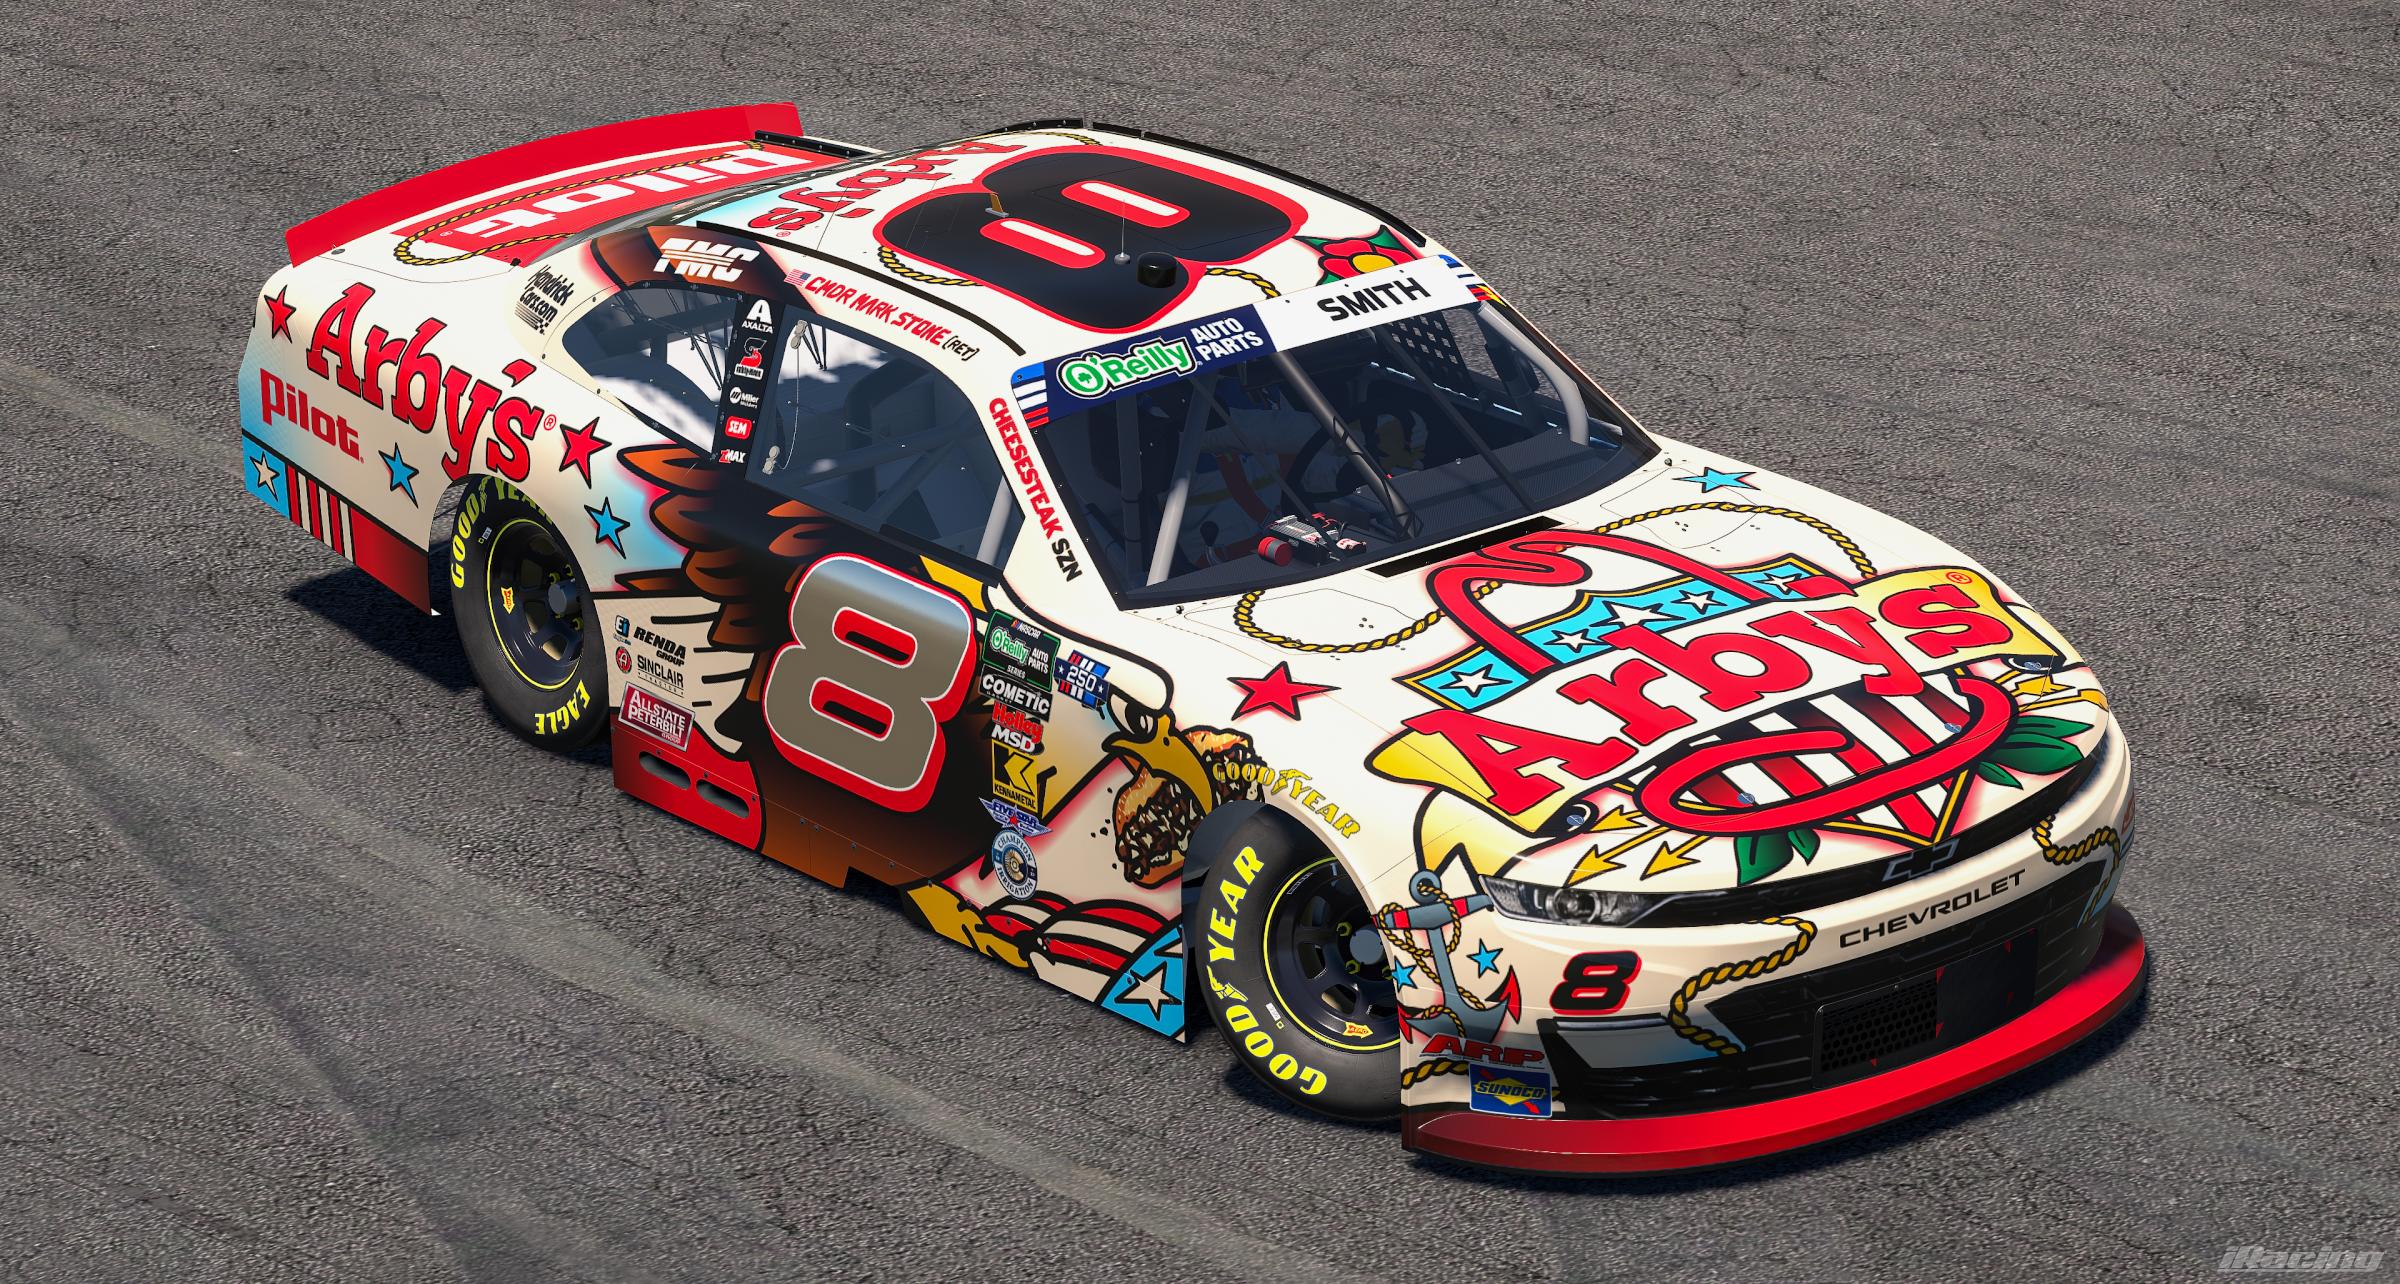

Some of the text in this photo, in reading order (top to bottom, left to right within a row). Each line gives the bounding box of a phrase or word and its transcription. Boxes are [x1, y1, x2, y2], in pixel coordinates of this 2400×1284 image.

[873, 144, 1309, 334] 8
[653, 238, 760, 282] TMC
[525, 264, 574, 306] Hendrick
[1317, 276, 1432, 323] SMITH
[519, 287, 558, 323] Cars.com
[805, 276, 857, 305] CMDR
[849, 293, 899, 323] MARK
[890, 311, 952, 346] STONE
[741, 320, 774, 334] AXALTA
[1190, 317, 1244, 344] AUTO
[1195, 331, 1264, 361] PARTS
[1061, 341, 1192, 395] O'Reilly
[740, 392, 760, 403] Miller
[260, 368, 361, 461] pilot
[728, 420, 748, 435] SEM
[989, 397, 1083, 582] CHEESESTEAK SZN
[633, 627, 686, 660] RENDA
[1012, 620, 1041, 639] NASCAR
[656, 650, 685, 667] GROUP
[991, 628, 1028, 664] O'Reilly
[1031, 647, 1049, 662] AUTO
[637, 654, 684, 688] SINCLAIR
[1007, 665, 1026, 679] SERIES
[1028, 657, 1049, 674] PARTS
[1066, 665, 1097, 692] 250
[763, 553, 976, 812] 8
[982, 674, 1050, 715] COMETIC
[534, 680, 591, 735] EAGLE
[992, 701, 1043, 743] Holley
[991, 724, 1035, 753] MSD
[993, 802, 1014, 816] FIVE
[995, 783, 1036, 810] KENNAMETAL
[997, 832, 1032, 862] CHAMPION
[997, 867, 1034, 896] IRRIGATION
[1840, 869, 2026, 948] CHEVROLET
[1550, 951, 1642, 1016] 8
[1421, 1034, 1545, 1066] ARP
[1477, 1081, 1545, 1099] SUNOCO
